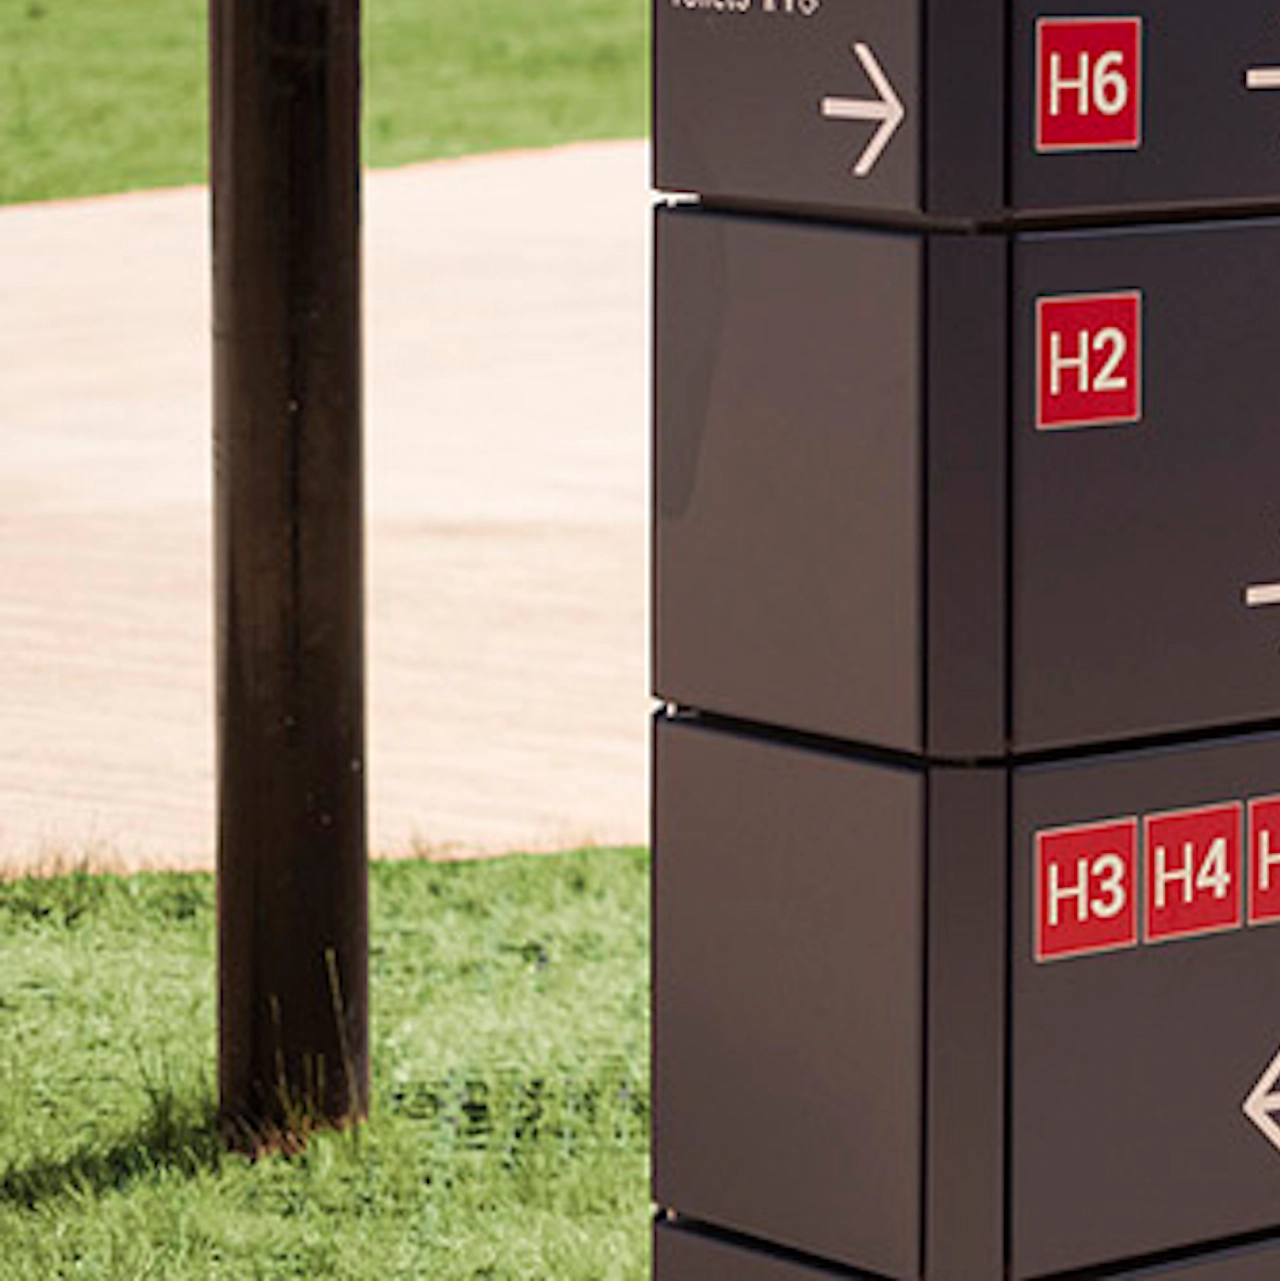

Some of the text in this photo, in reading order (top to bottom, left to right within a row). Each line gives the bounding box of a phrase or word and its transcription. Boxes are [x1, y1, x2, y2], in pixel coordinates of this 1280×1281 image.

[1048, 49, 1129, 116] H6
[1048, 325, 1128, 395] H2
[1047, 853, 1126, 926] H3
[1154, 836, 1231, 909] H4
